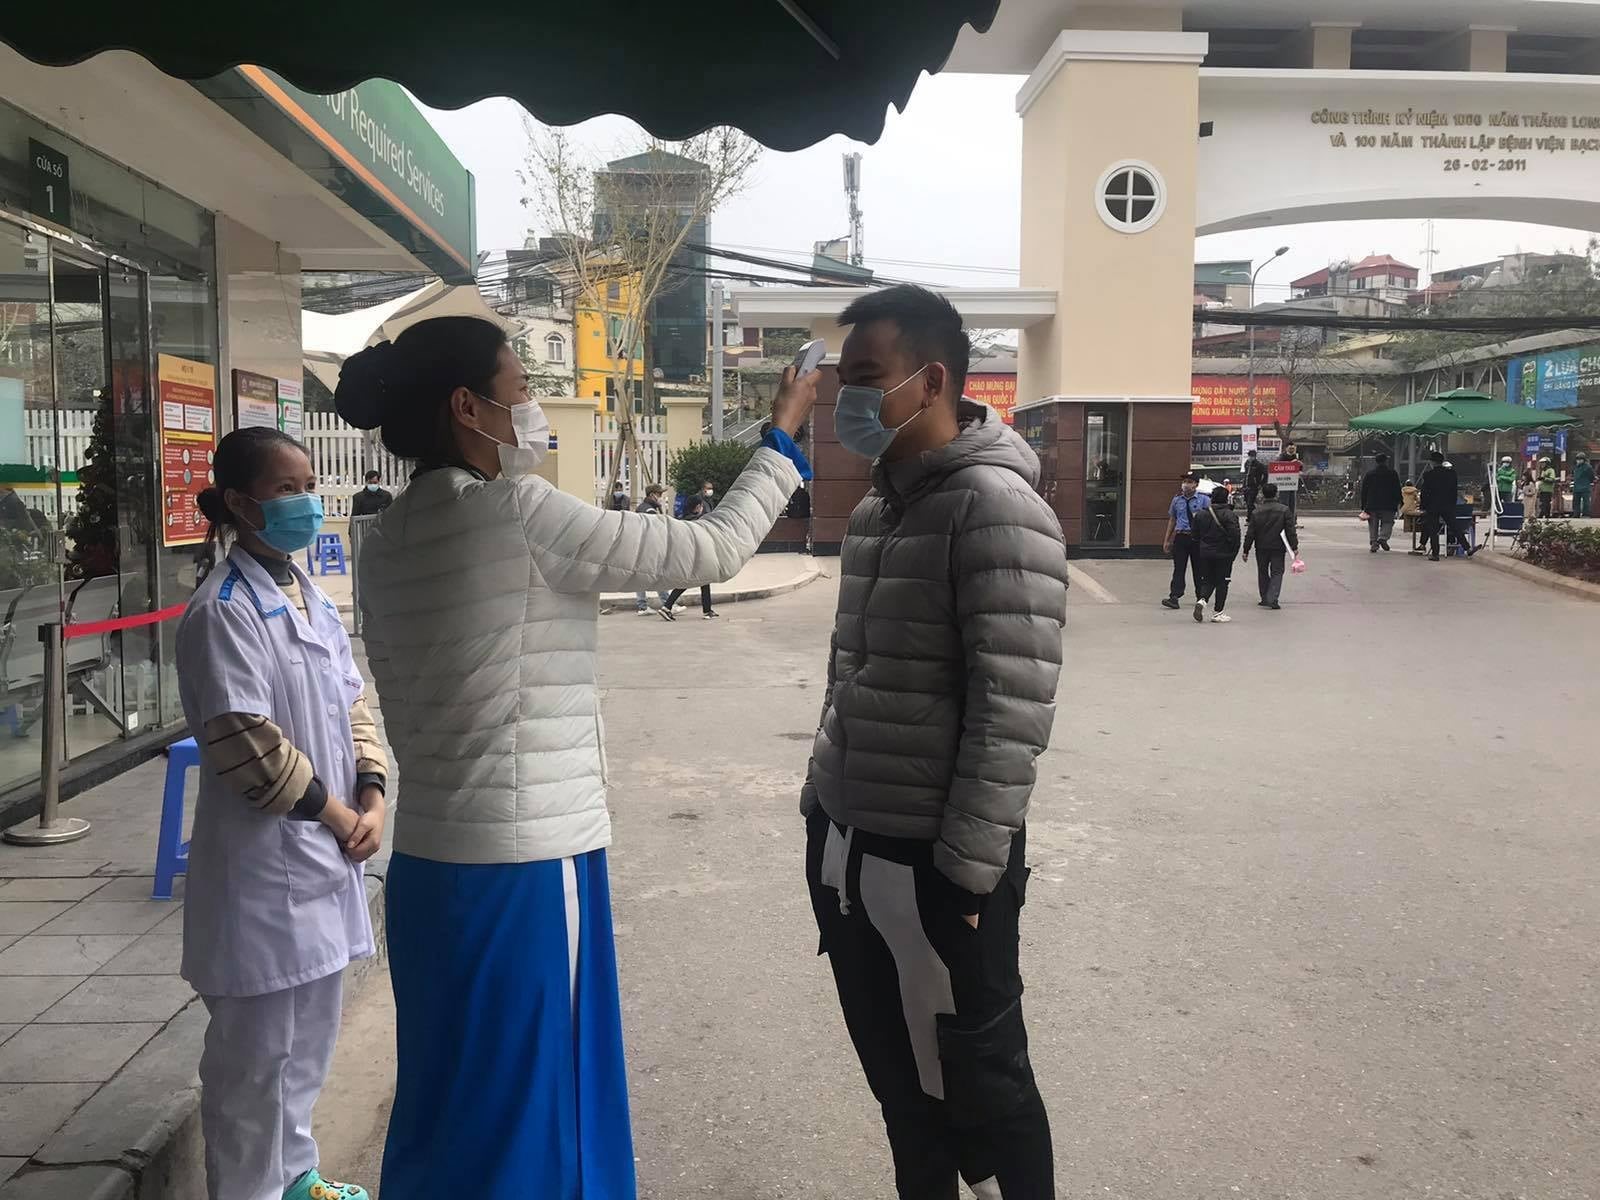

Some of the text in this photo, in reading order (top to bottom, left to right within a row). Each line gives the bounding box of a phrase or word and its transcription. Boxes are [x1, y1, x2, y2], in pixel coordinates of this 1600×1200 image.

[350, 87, 405, 180] Required
[406, 150, 445, 217] Services
[1330, 132, 1347, 147] VÀ
[1354, 136, 1377, 148] 100
[1380, 132, 1413, 148] NĂM
[1421, 133, 1467, 149] THÀNH
[1470, 134, 1495, 152] LẬP
[1498, 134, 1533, 153] BỆNH
[1535, 135, 1565, 154] VIỆN
[46, 185, 54, 213] 1
[1544, 360, 1554, 377] 2
[1191, 441, 1239, 452] SAMSUNG
